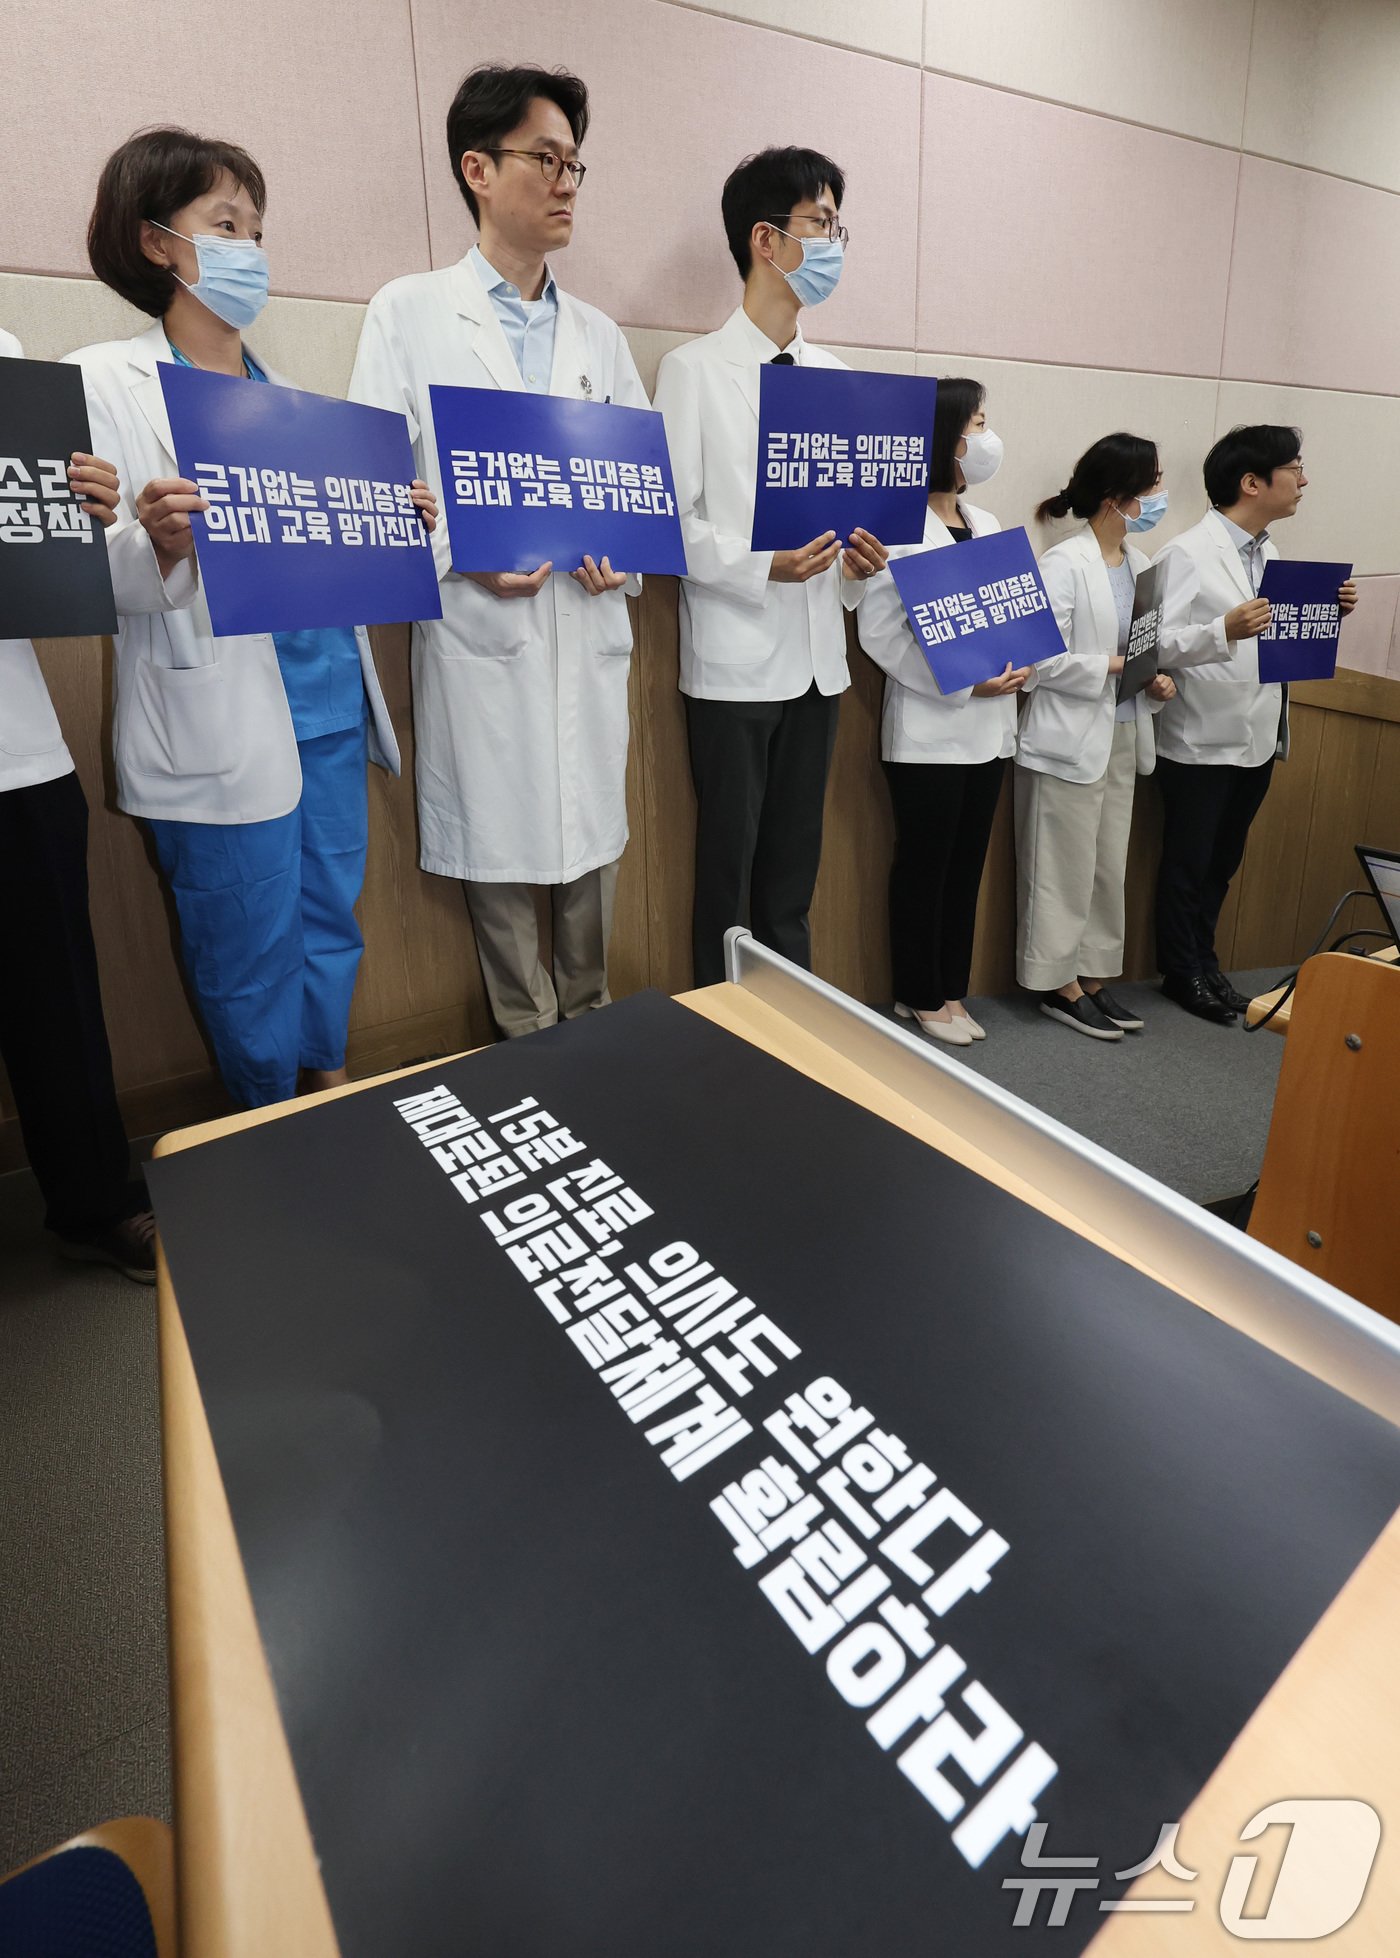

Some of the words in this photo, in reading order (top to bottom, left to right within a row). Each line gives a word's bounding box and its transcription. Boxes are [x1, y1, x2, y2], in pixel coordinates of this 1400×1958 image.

[766, 431, 850, 460] 근거없는
[855, 434, 925, 461] 의대증원
[194, 462, 319, 508] 근거없는
[324, 476, 416, 515] 의대증원
[450, 449, 562, 481] 근거없는
[569, 457, 665, 490] 의대증원
[765, 461, 809, 488] 의대
[815, 462, 854, 488] 교육
[860, 462, 928, 488] 망가진다
[454, 478, 512, 506] 의대
[520, 480, 573, 509] 교육
[579, 484, 675, 517] 망가진다
[203, 505, 271, 544] 의대
[276, 509, 332, 545] 교육
[337, 513, 428, 548] 망가진다
[912, 592, 978, 627] 근거없는
[978, 571, 1038, 607] 의대증원
[921, 619, 957, 647] 의대
[955, 608, 989, 636] 교육
[989, 590, 1048, 625] 망가진다
[1270, 603, 1299, 621] 거없는
[1300, 603, 1339, 621] 의대증원
[1279, 622, 1299, 639] 교육
[1300, 621, 1339, 639] 망가진다
[487, 1096, 587, 1172] 15분
[545, 1158, 655, 1257] 진료,
[623, 1240, 801, 1397] 의사도
[762, 1376, 1011, 1617] 원한다
[392, 1084, 528, 1204] 제대로된
[479, 1193, 753, 1482] 의료전달체계
[708, 1455, 1059, 1870] 확립하라
